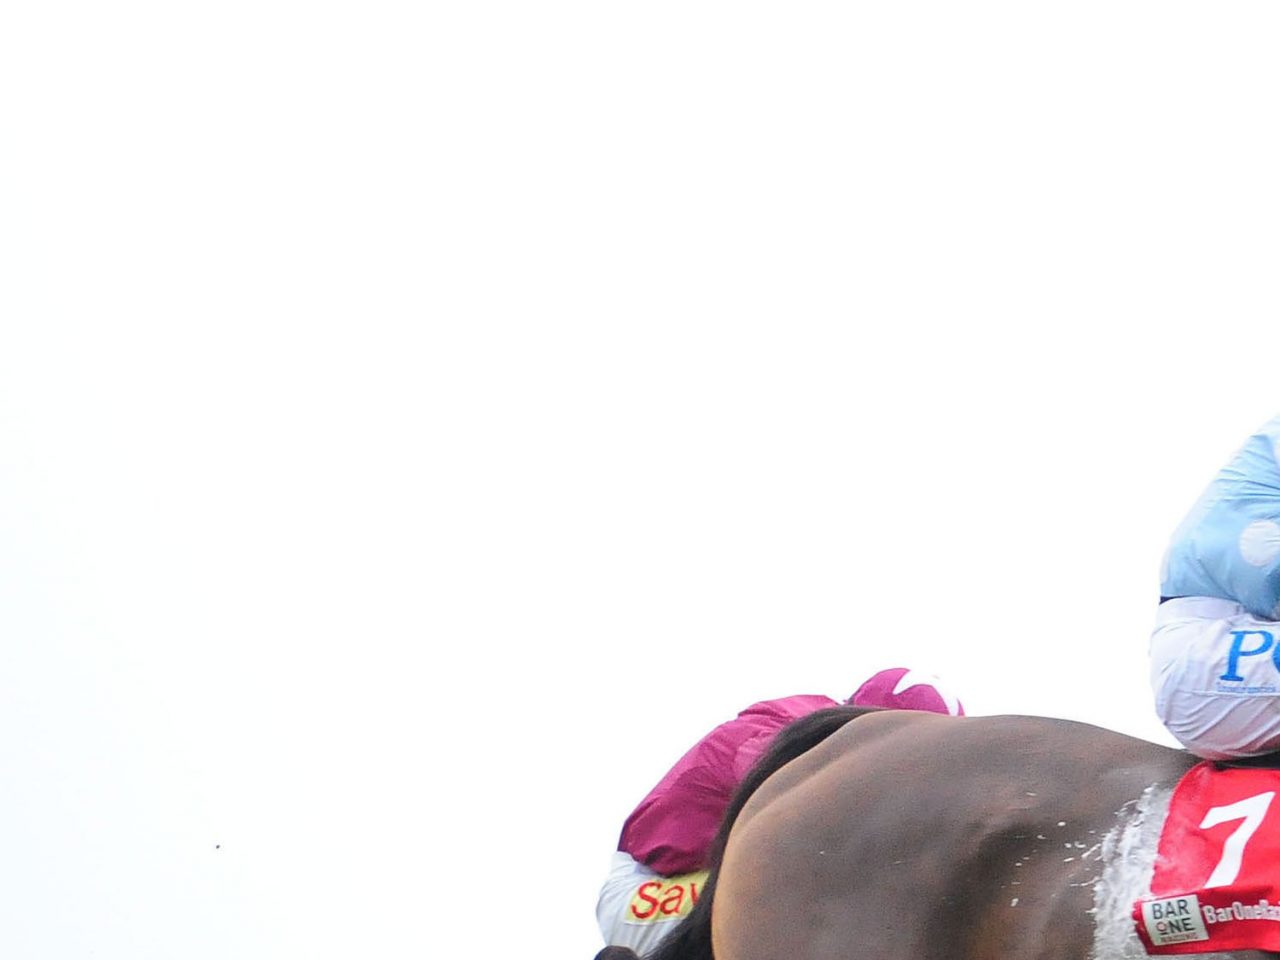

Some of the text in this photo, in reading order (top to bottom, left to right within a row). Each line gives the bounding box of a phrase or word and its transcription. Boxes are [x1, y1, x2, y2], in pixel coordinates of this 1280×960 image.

[1199, 791, 1277, 889] 7
[1152, 899, 1191, 919] BAR
[1156, 917, 1196, 935] ONE
